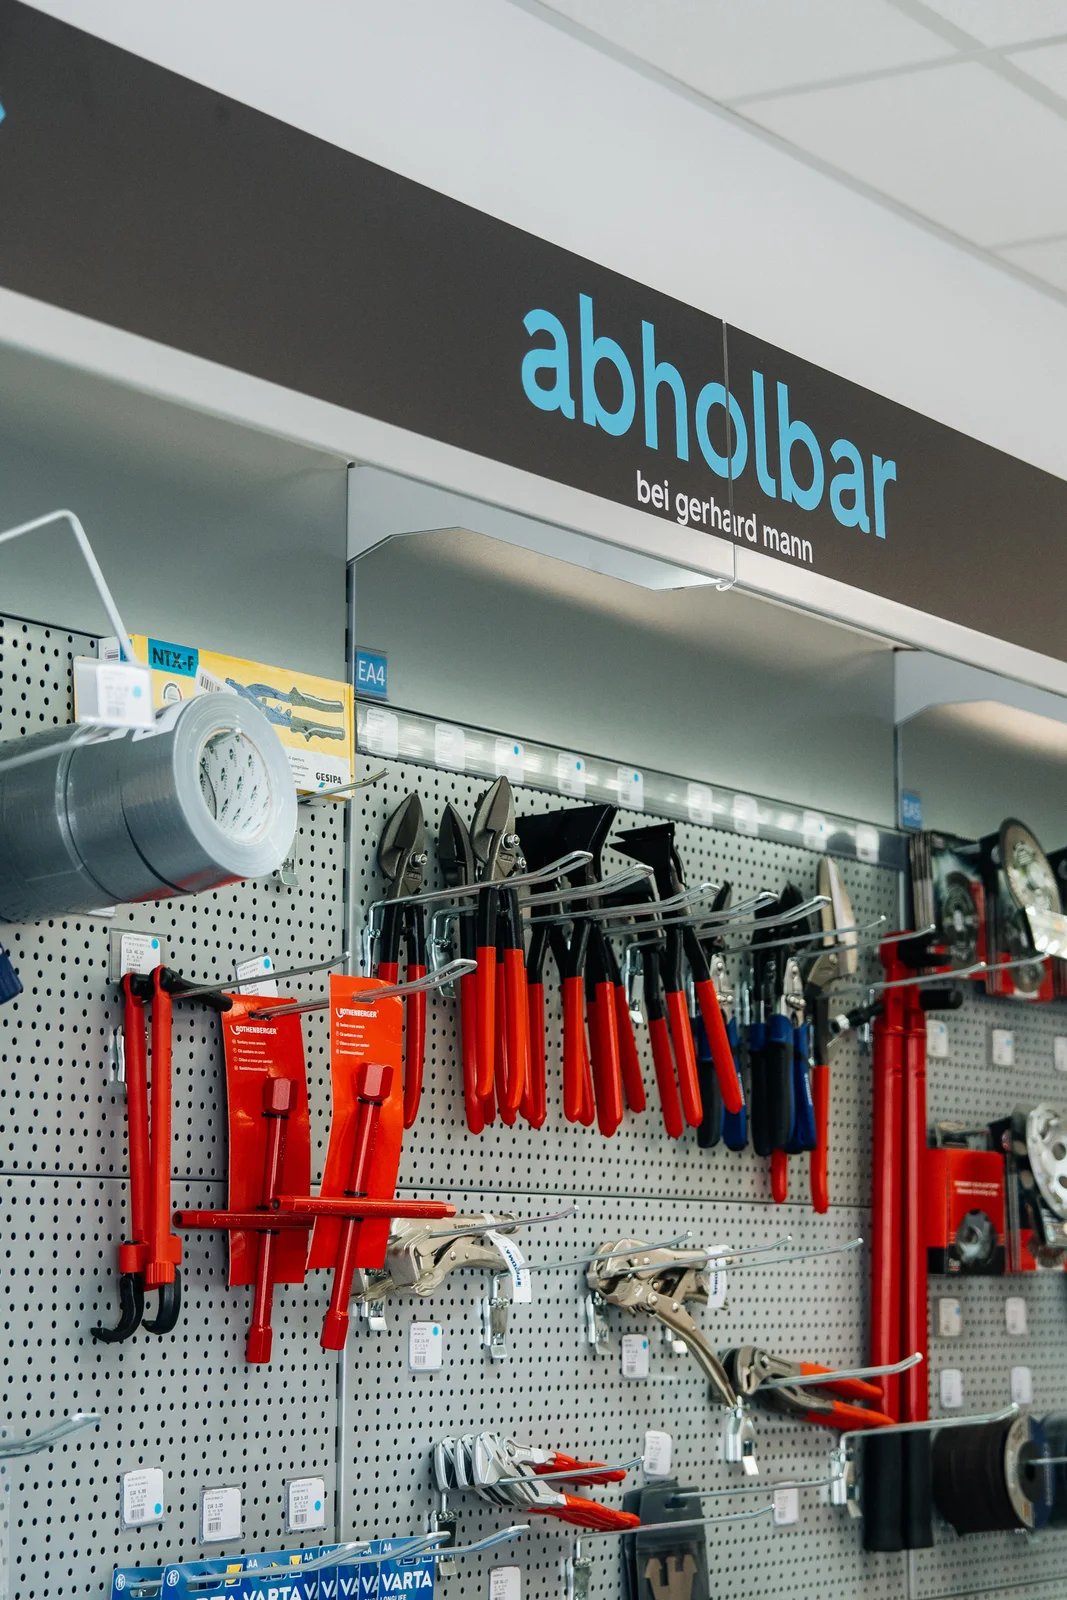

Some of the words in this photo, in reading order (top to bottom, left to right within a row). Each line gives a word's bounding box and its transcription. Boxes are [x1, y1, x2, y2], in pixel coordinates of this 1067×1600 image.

[521, 293, 897, 539] abholbar
[636, 470, 669, 511] bei
[675, 497, 757, 543] gerhard
[763, 525, 813, 563] mann
[152, 646, 195, 672] NTX-F
[358, 659, 385, 686] EA4
[315, 772, 342, 785] GESIPA
[340, 1008, 377, 1018] ROTHENBERGER
[235, 1025, 277, 1035] ROTHENBERGER
[383, 1542, 392, 1551] AA
[304, 1552, 314, 1560] AA
[246, 1559, 258, 1568] AA
[381, 1570, 433, 1592] VARTA
